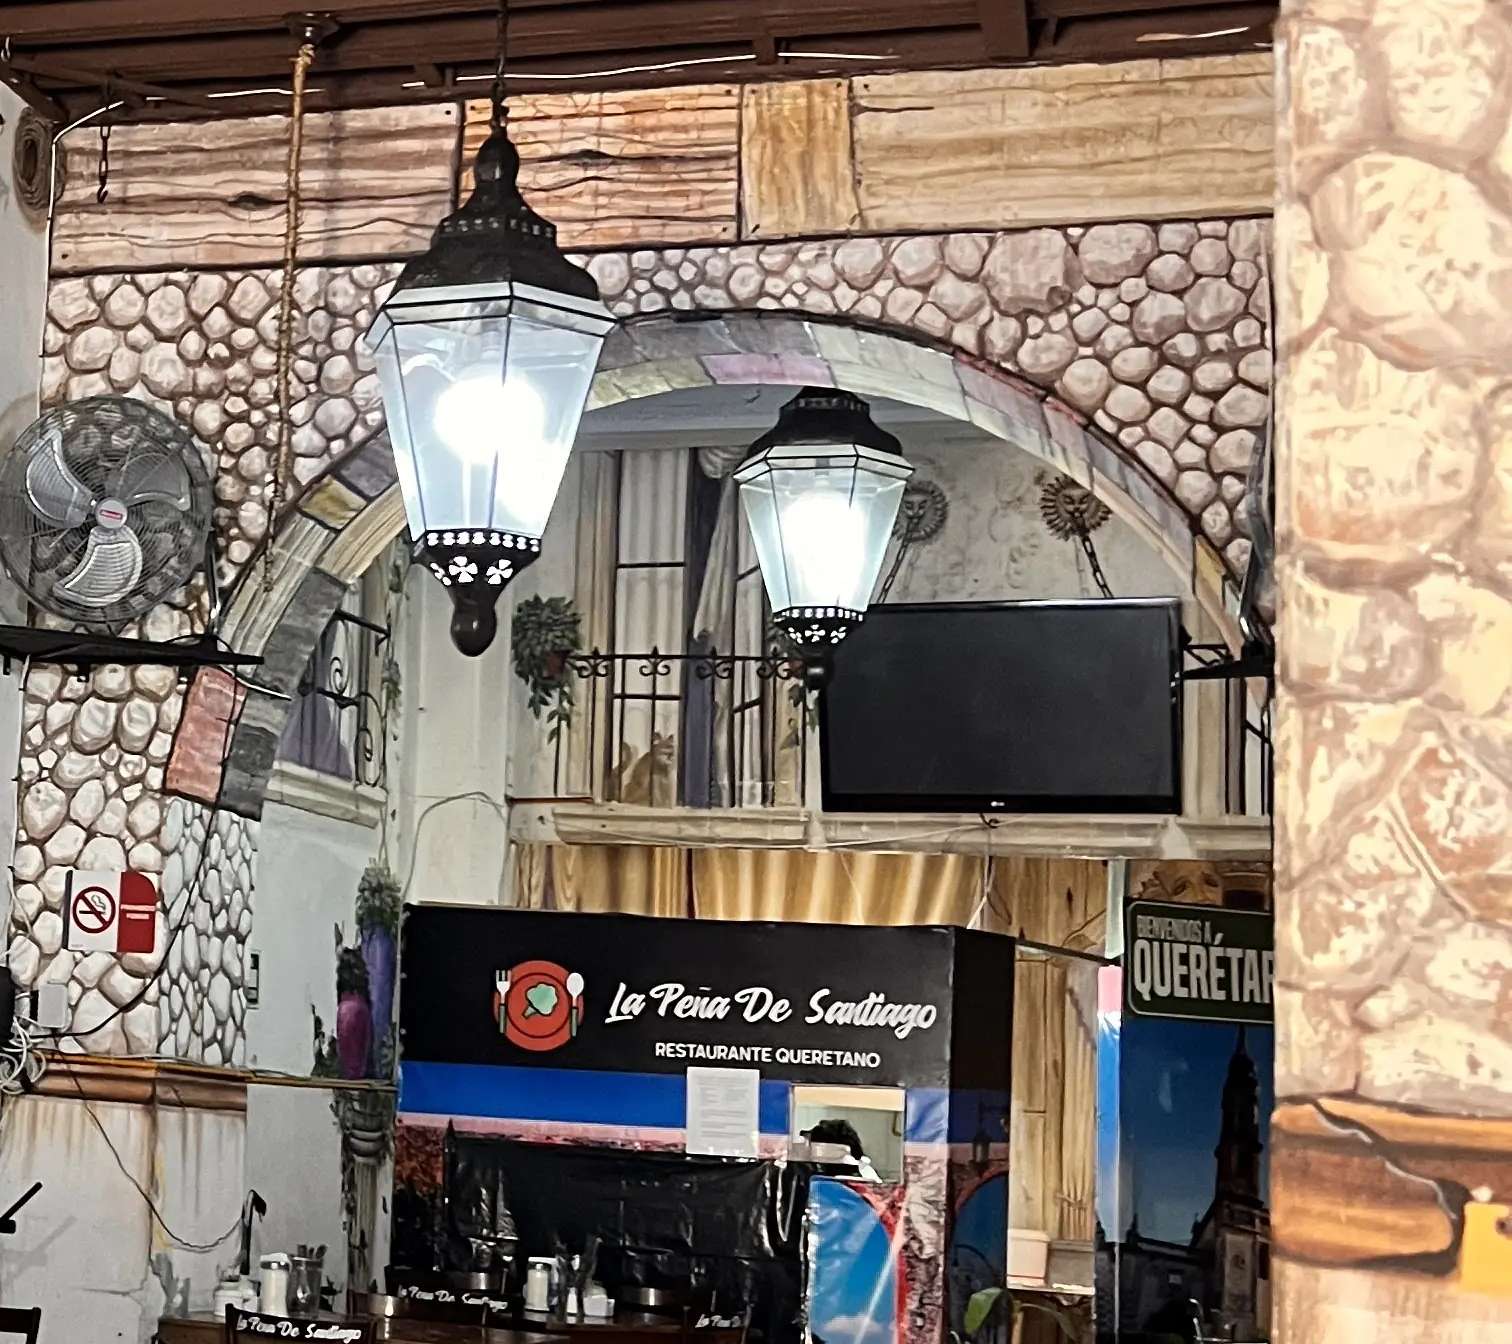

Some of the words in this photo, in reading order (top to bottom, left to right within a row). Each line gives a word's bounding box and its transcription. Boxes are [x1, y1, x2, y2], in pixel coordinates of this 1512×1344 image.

[604, 982, 646, 1024] La
[649, 982, 731, 1019] Peña
[734, 986, 793, 1023] De
[804, 988, 938, 1040] Santiago
[655, 1042, 772, 1063] RESTAURANTE
[775, 1046, 882, 1069] QUERETANO
